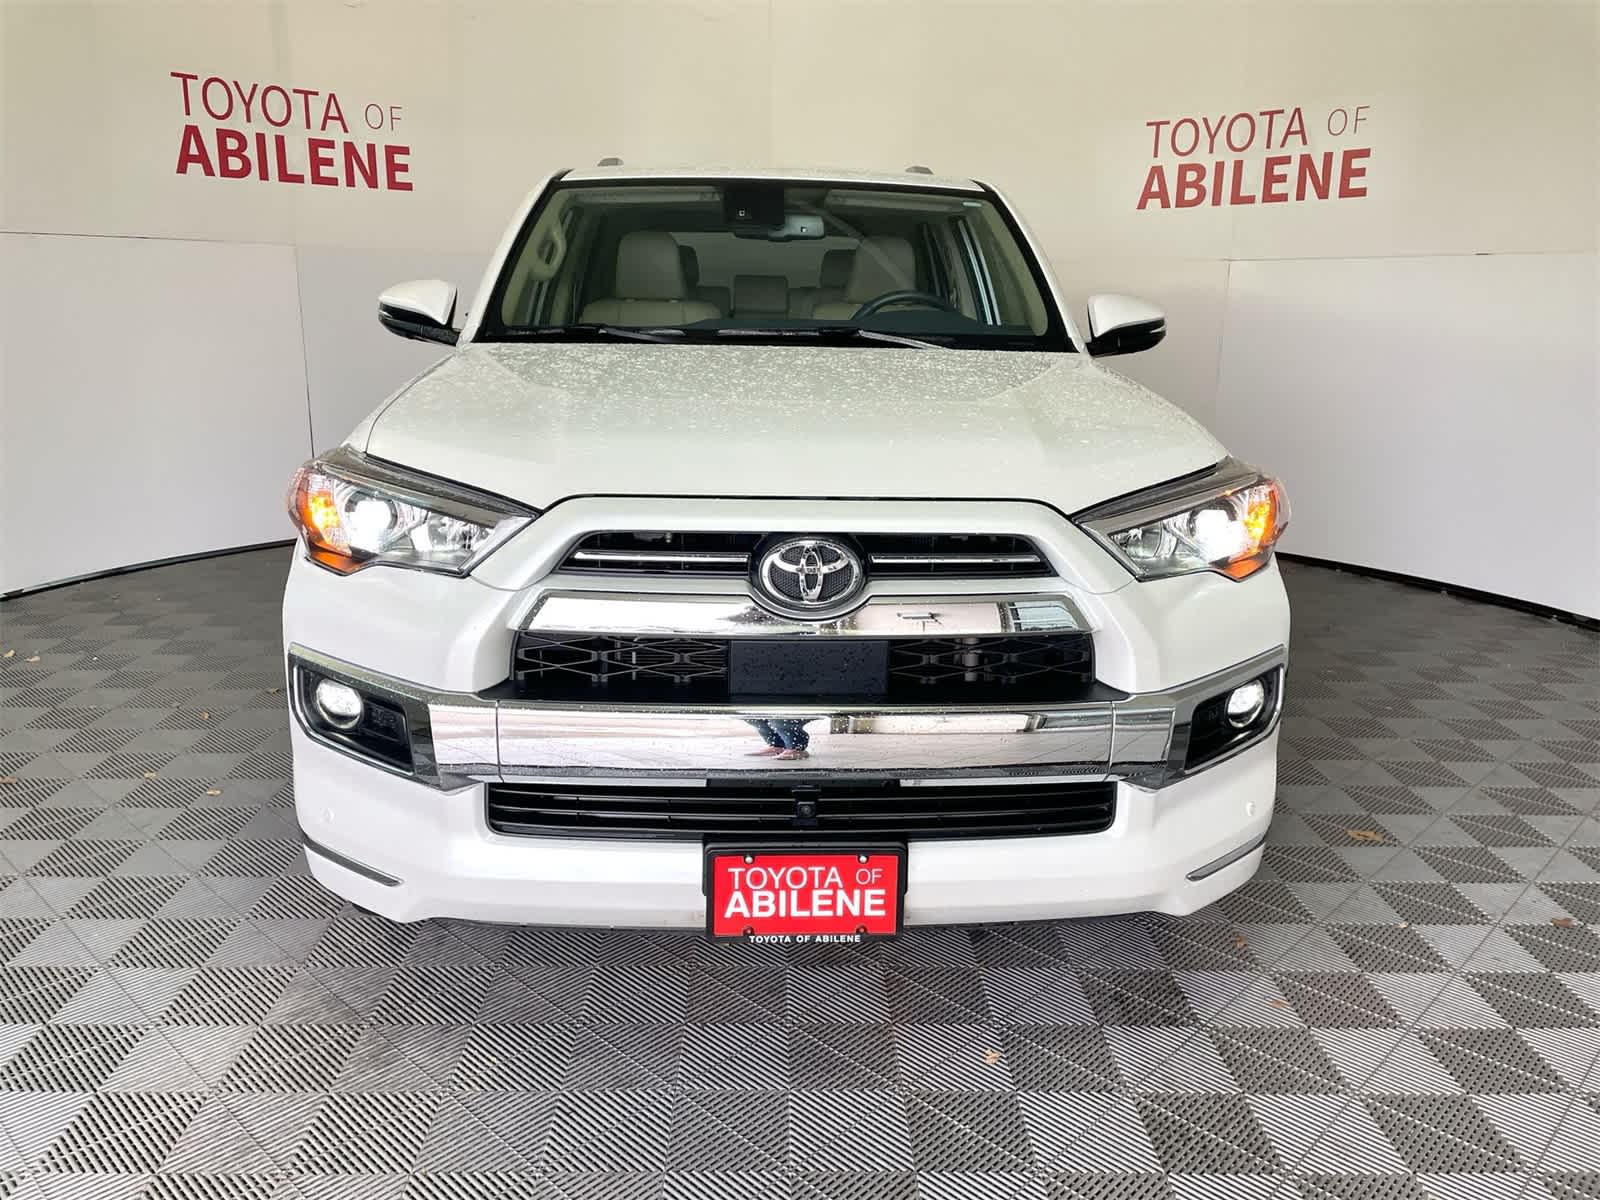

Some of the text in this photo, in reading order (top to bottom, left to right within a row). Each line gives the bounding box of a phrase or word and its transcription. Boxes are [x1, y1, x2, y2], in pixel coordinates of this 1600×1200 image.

[169, 70, 403, 134] TOYOTA OF
[176, 123, 414, 192] ABILENE
[1145, 105, 1371, 159] TOYOTA OF
[1136, 148, 1372, 211] ABILENE
[724, 888, 886, 918] ABILENE
[727, 866, 883, 890] TOYOTA OF
[749, 934, 861, 944] TOYOTA OF ABILENE
